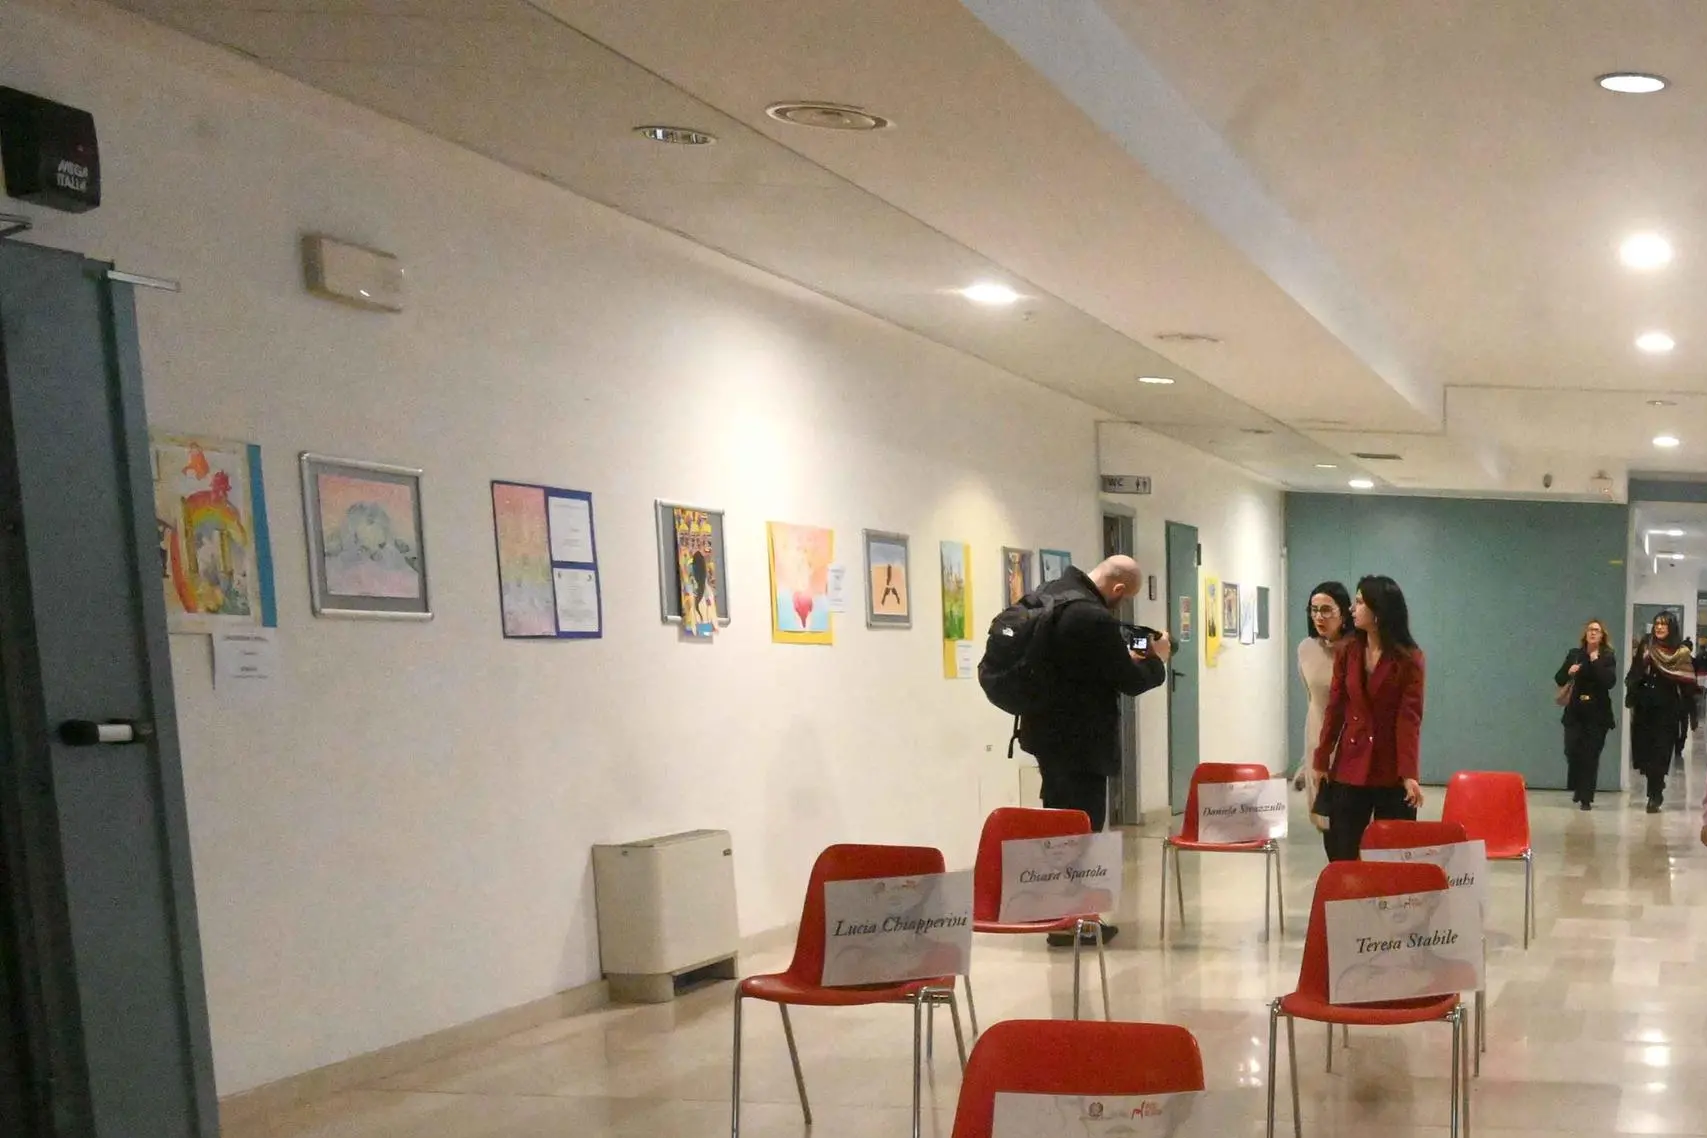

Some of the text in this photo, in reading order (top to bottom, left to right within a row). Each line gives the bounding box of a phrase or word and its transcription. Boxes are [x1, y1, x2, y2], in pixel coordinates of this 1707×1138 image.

[1019, 864, 1108, 884] Chiara Spatola
[832, 910, 970, 937] Lucia Chiapperini
[1356, 929, 1459, 954] Teresa Stabile
